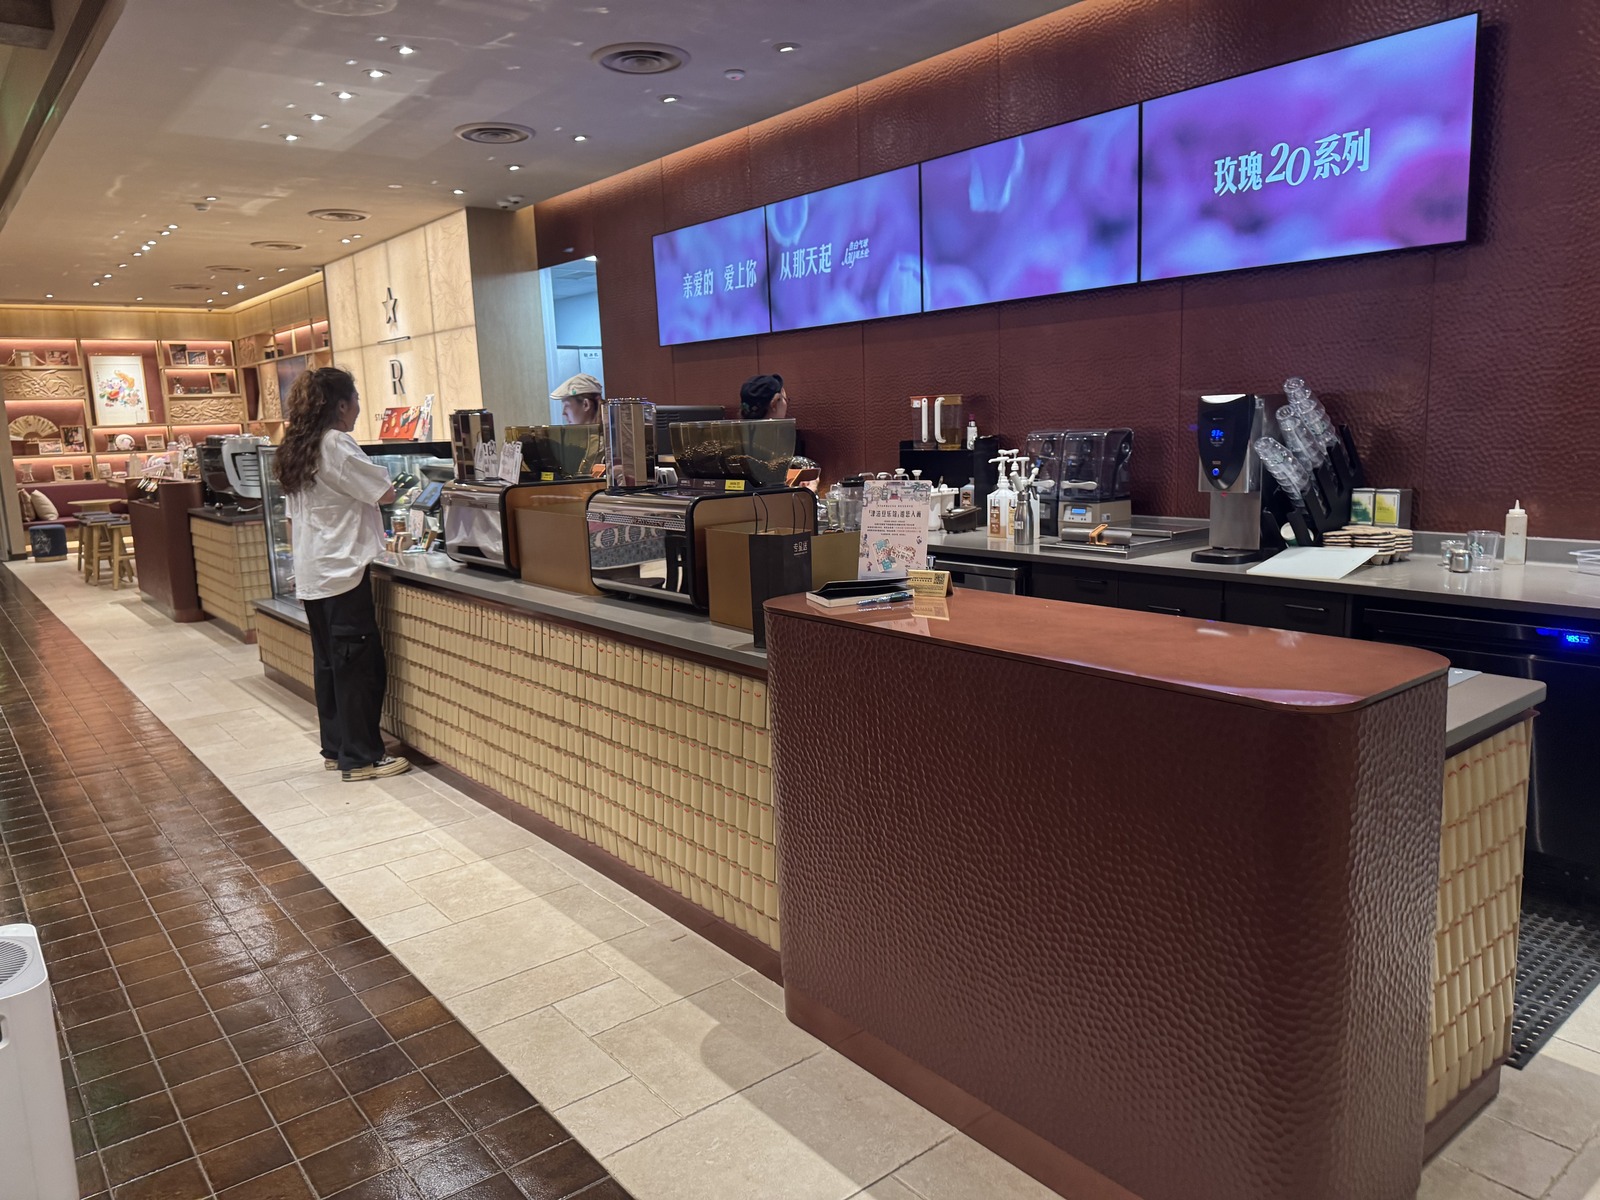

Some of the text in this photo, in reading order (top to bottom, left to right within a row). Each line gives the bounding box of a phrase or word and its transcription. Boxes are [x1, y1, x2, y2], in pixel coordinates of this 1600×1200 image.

[1213, 127, 1371, 197] 玫瑰20系列
[683, 242, 833, 299] 亲爱的 爱上你 从那天起
[389, 359, 406, 395] R
